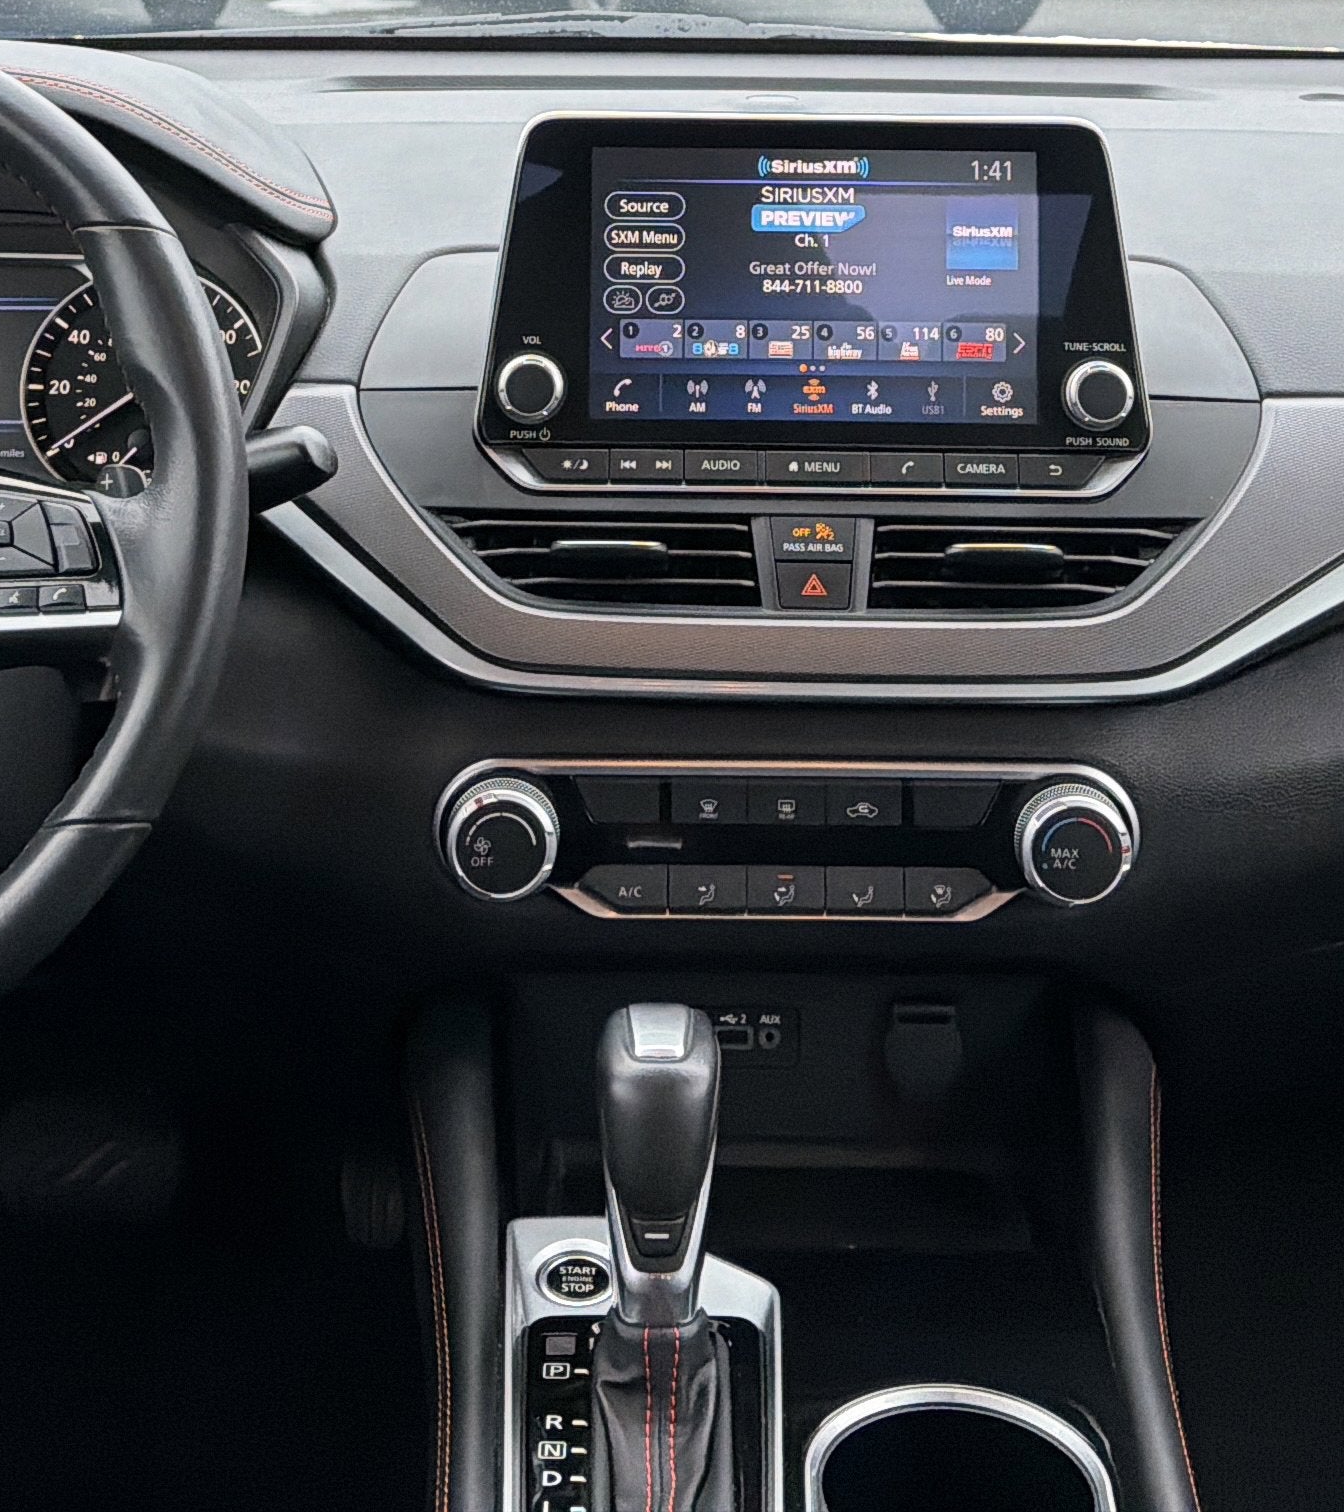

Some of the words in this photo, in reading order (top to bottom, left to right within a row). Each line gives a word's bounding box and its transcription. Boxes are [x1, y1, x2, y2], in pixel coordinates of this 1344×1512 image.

[970, 160, 1013, 181] 1:41
[760, 186, 855, 204] SIRIUSXM
[619, 199, 669, 213] Source
[760, 210, 855, 227] PREVIEW
[610, 230, 639, 244] SXM
[642, 230, 678, 244] Menu
[952, 225, 1013, 238] SiriusXM
[794, 233, 818, 247] Ch.
[822, 234, 829, 248] 1
[620, 261, 663, 279] Replay
[749, 261, 791, 275] Great
[796, 261, 835, 276] Offer
[838, 261, 877, 276] Now!
[946, 275, 965, 286] Live
[965, 275, 992, 286] Mode
[762, 279, 863, 294] 844-711-8800
[627, 325, 634, 336] 1
[672, 324, 683, 338] 2
[692, 326, 699, 336] 2
[735, 324, 747, 338] 8
[756, 326, 763, 336] 3
[791, 325, 810, 339] 25
[820, 327, 829, 337] 4
[856, 326, 875, 340] 56
[885, 328, 893, 338] 5
[912, 327, 940, 341] 114
[950, 328, 958, 339] 6
[985, 327, 1004, 341] 80
[68, 329, 91, 345] 40
[522, 335, 542, 345] VOL
[93, 352, 106, 362] 60
[84, 374, 98, 383] 40
[49, 380, 71, 395] 20
[84, 398, 97, 407] 20
[605, 401, 640, 413] Phone
[688, 402, 706, 413] AM
[747, 402, 762, 413] FM
[792, 403, 835, 414] SiriusXM
[851, 404, 865, 414] BT
[865, 404, 893, 415] Audio
[980, 405, 1024, 417] Settings
[510, 429, 537, 439] PUSH
[1065, 436, 1093, 446] PUSH
[1096, 437, 1130, 447] SOUND
[0, 448, 25, 458] miles
[112, 451, 121, 462] 0
[701, 460, 741, 471] AUDIO
[804, 461, 841, 473] MENU
[957, 463, 1006, 475] CAMERA
[792, 527, 812, 537] OFF
[782, 542, 805, 552] PASS
[807, 543, 823, 552] AIR
[824, 543, 844, 553] BAG
[1050, 848, 1080, 859] MAX
[470, 856, 494, 868] OFF
[1052, 859, 1077, 870] A/C
[618, 886, 643, 898] A/C
[739, 1013, 748, 1024] 2
[758, 1014, 781, 1025] AUX
[558, 1265, 598, 1276] START
[561, 1283, 595, 1293] STOP
[549, 1366, 564, 1377] P
[545, 1414, 563, 1430] R
[543, 1443, 561, 1457] N
[542, 1470, 563, 1487] D
